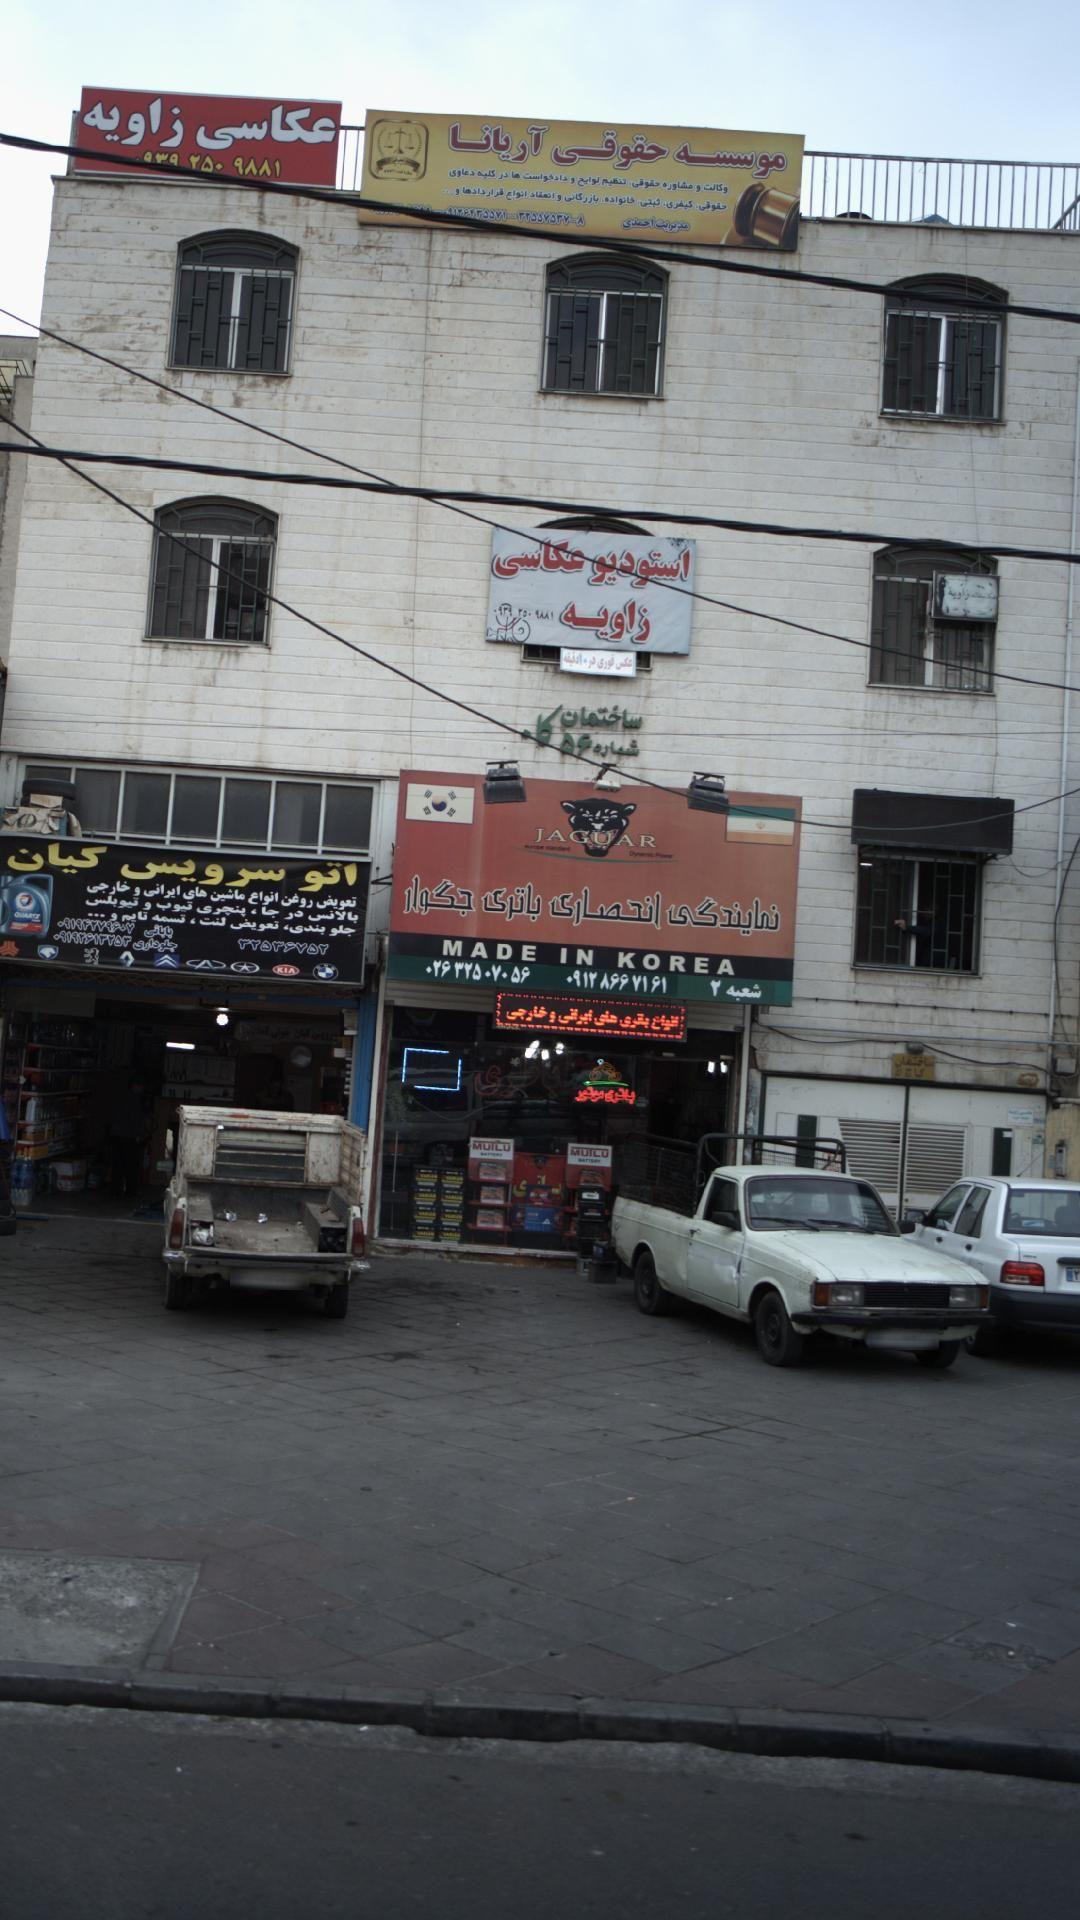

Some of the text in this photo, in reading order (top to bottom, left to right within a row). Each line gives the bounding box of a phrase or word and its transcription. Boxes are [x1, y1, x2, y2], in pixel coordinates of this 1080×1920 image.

[84, 97, 337, 150] عکاسی زاویه
[449, 121, 787, 179] موسسه حقوقی آریانا
[136, 151, 179, 166] ۹۳۹
[233, 156, 281, 177] ۹۸۸۱
[448, 168, 475, 178] دعاوی
[477, 169, 496, 178] کلیه
[498, 171, 508, 180] در
[511, 171, 520, 179] ها
[523, 173, 568, 183] دادخواست
[577, 176, 600, 187] لوایح
[601, 178, 627, 187] تنظیم
[662, 181, 693, 191] مشاوره
[463, 187, 504, 197] قراردادها
[506, 190, 527, 200] انواع
[703, 184, 728, 194] وکالت
[564, 193, 599, 204] بازرگانی
[622, 217, 689, 232] مدیریت احمدی
[492, 538, 691, 588] استودیو عکاسی
[560, 599, 651, 643] زاویه
[560, 704, 643, 729] ساختمان
[593, 740, 640, 757] شماره
[535, 828, 657, 848] JAGUAR
[7, 842, 358, 892] اتو سرویس کیان
[87, 880, 357, 910] تعویض روغن انواع ماشین های ایرانی و خارجی
[85, 895, 139, 908] تیوبلس
[144, 901, 151, 910] و
[156, 902, 192, 912] تیوب
[403, 874, 781, 937] نمایندگی انحصاری باتری جگوار
[121, 911, 147, 922] تایم
[196, 904, 246, 917] پنچری
[284, 909, 304, 920] در
[111, 913, 118, 922] و
[152, 913, 186, 924] تسمه
[199, 917, 226, 926] لنت
[308, 911, 358, 924] بالانس
[230, 918, 279, 931] تعویض
[329, 924, 356, 936] جلو
[133, 938, 178, 953] جلوداری
[442, 939, 735, 976] MADE IN KOREA
[710, 979, 762, 1001] شعبه ۲
